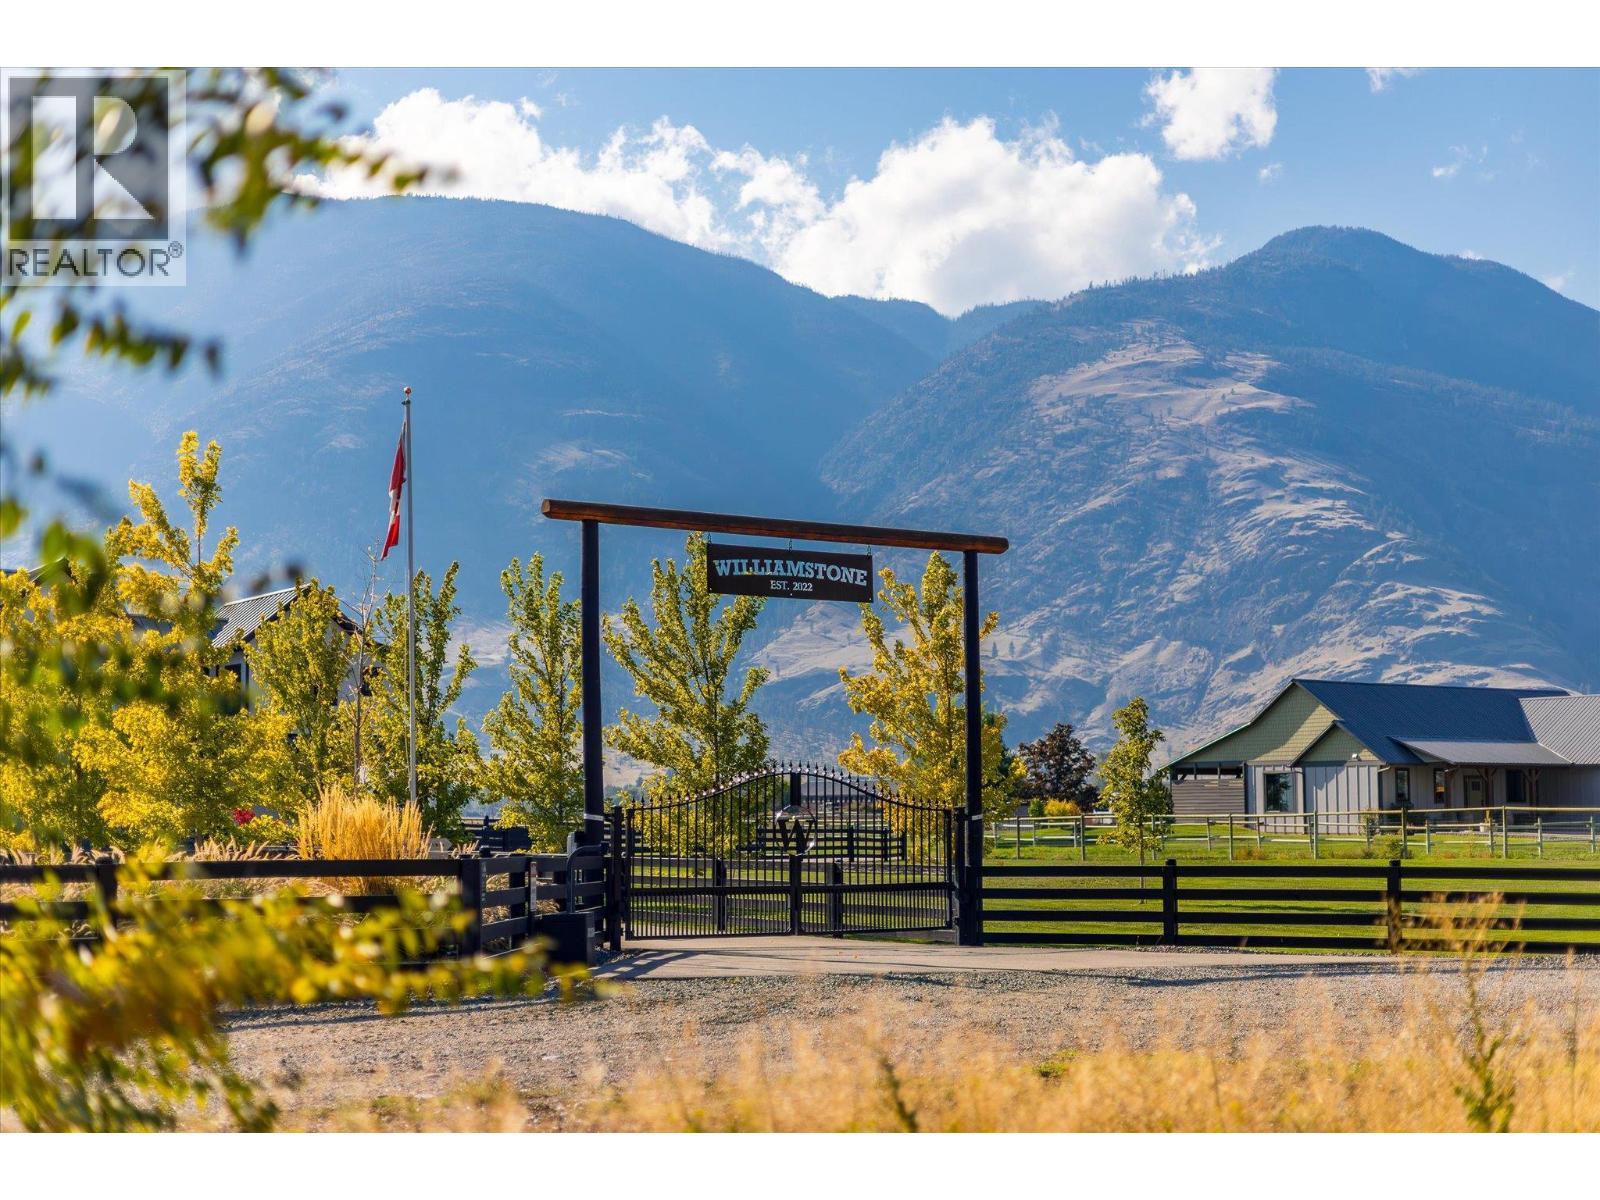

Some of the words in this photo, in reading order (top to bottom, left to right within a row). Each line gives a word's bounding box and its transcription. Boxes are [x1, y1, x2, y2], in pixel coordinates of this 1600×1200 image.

[713, 559, 867, 586] WILLIAMSTONE
[770, 580, 790, 591] EST.
[792, 582, 813, 592] 2022
[777, 819, 817, 853] W
